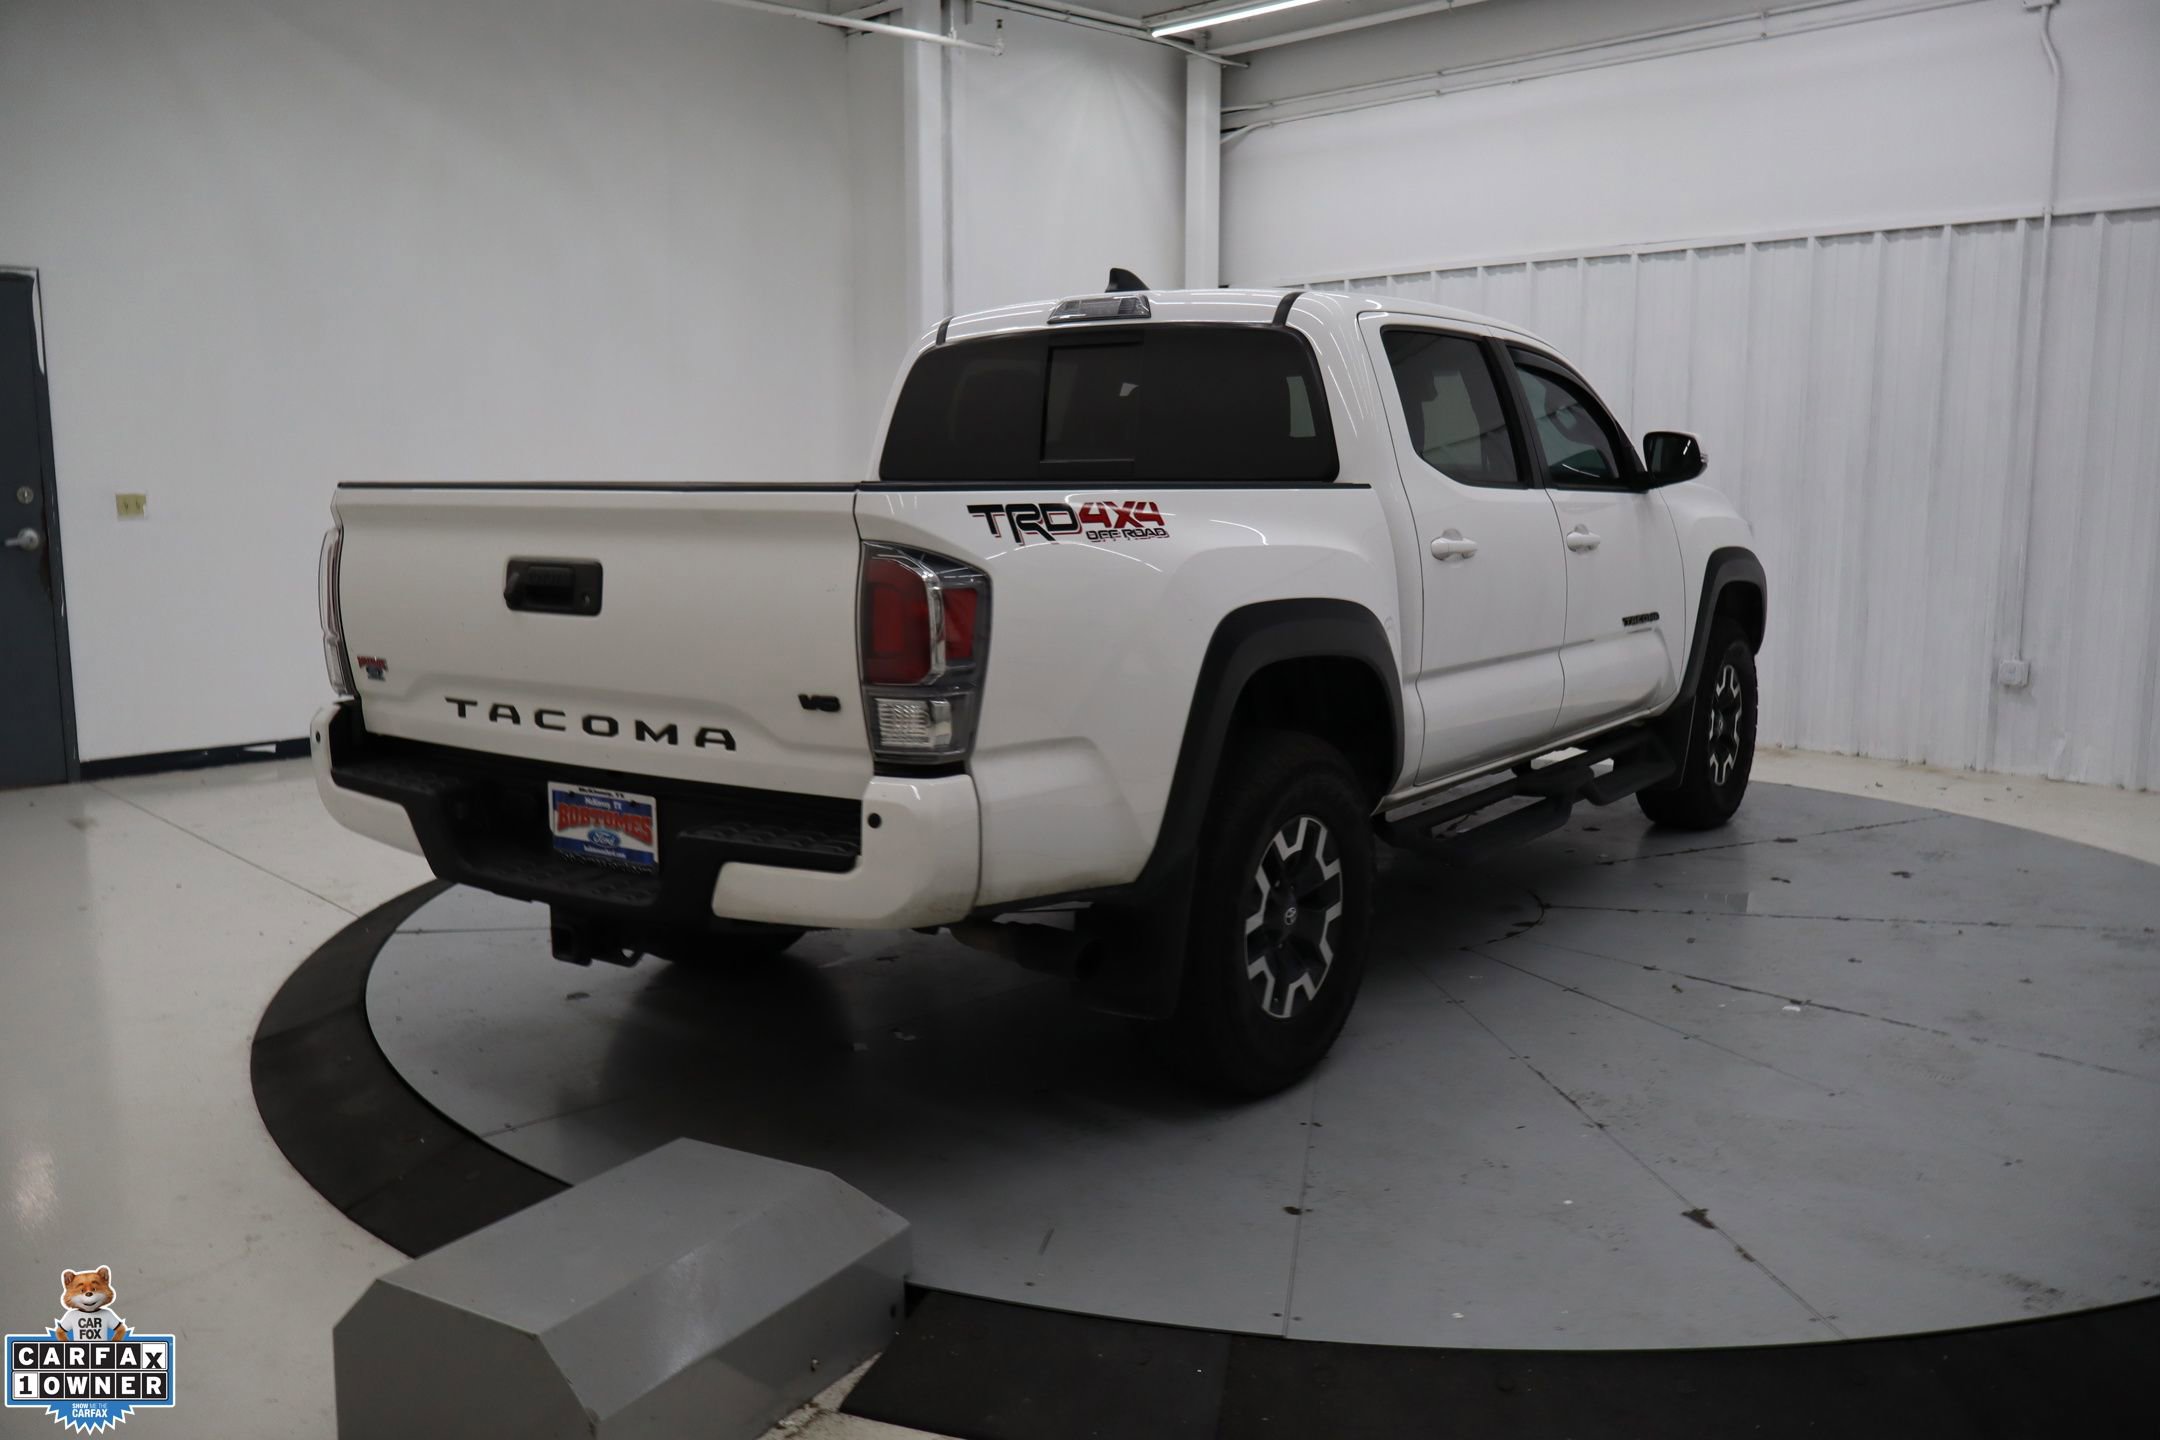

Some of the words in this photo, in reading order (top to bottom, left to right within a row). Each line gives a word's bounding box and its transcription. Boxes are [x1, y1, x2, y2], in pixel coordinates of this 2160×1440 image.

[967, 503, 1082, 545] TRD
[1086, 529, 1121, 542] OFF
[1122, 528, 1169, 541] ROAD
[445, 696, 736, 751] TACOMA
